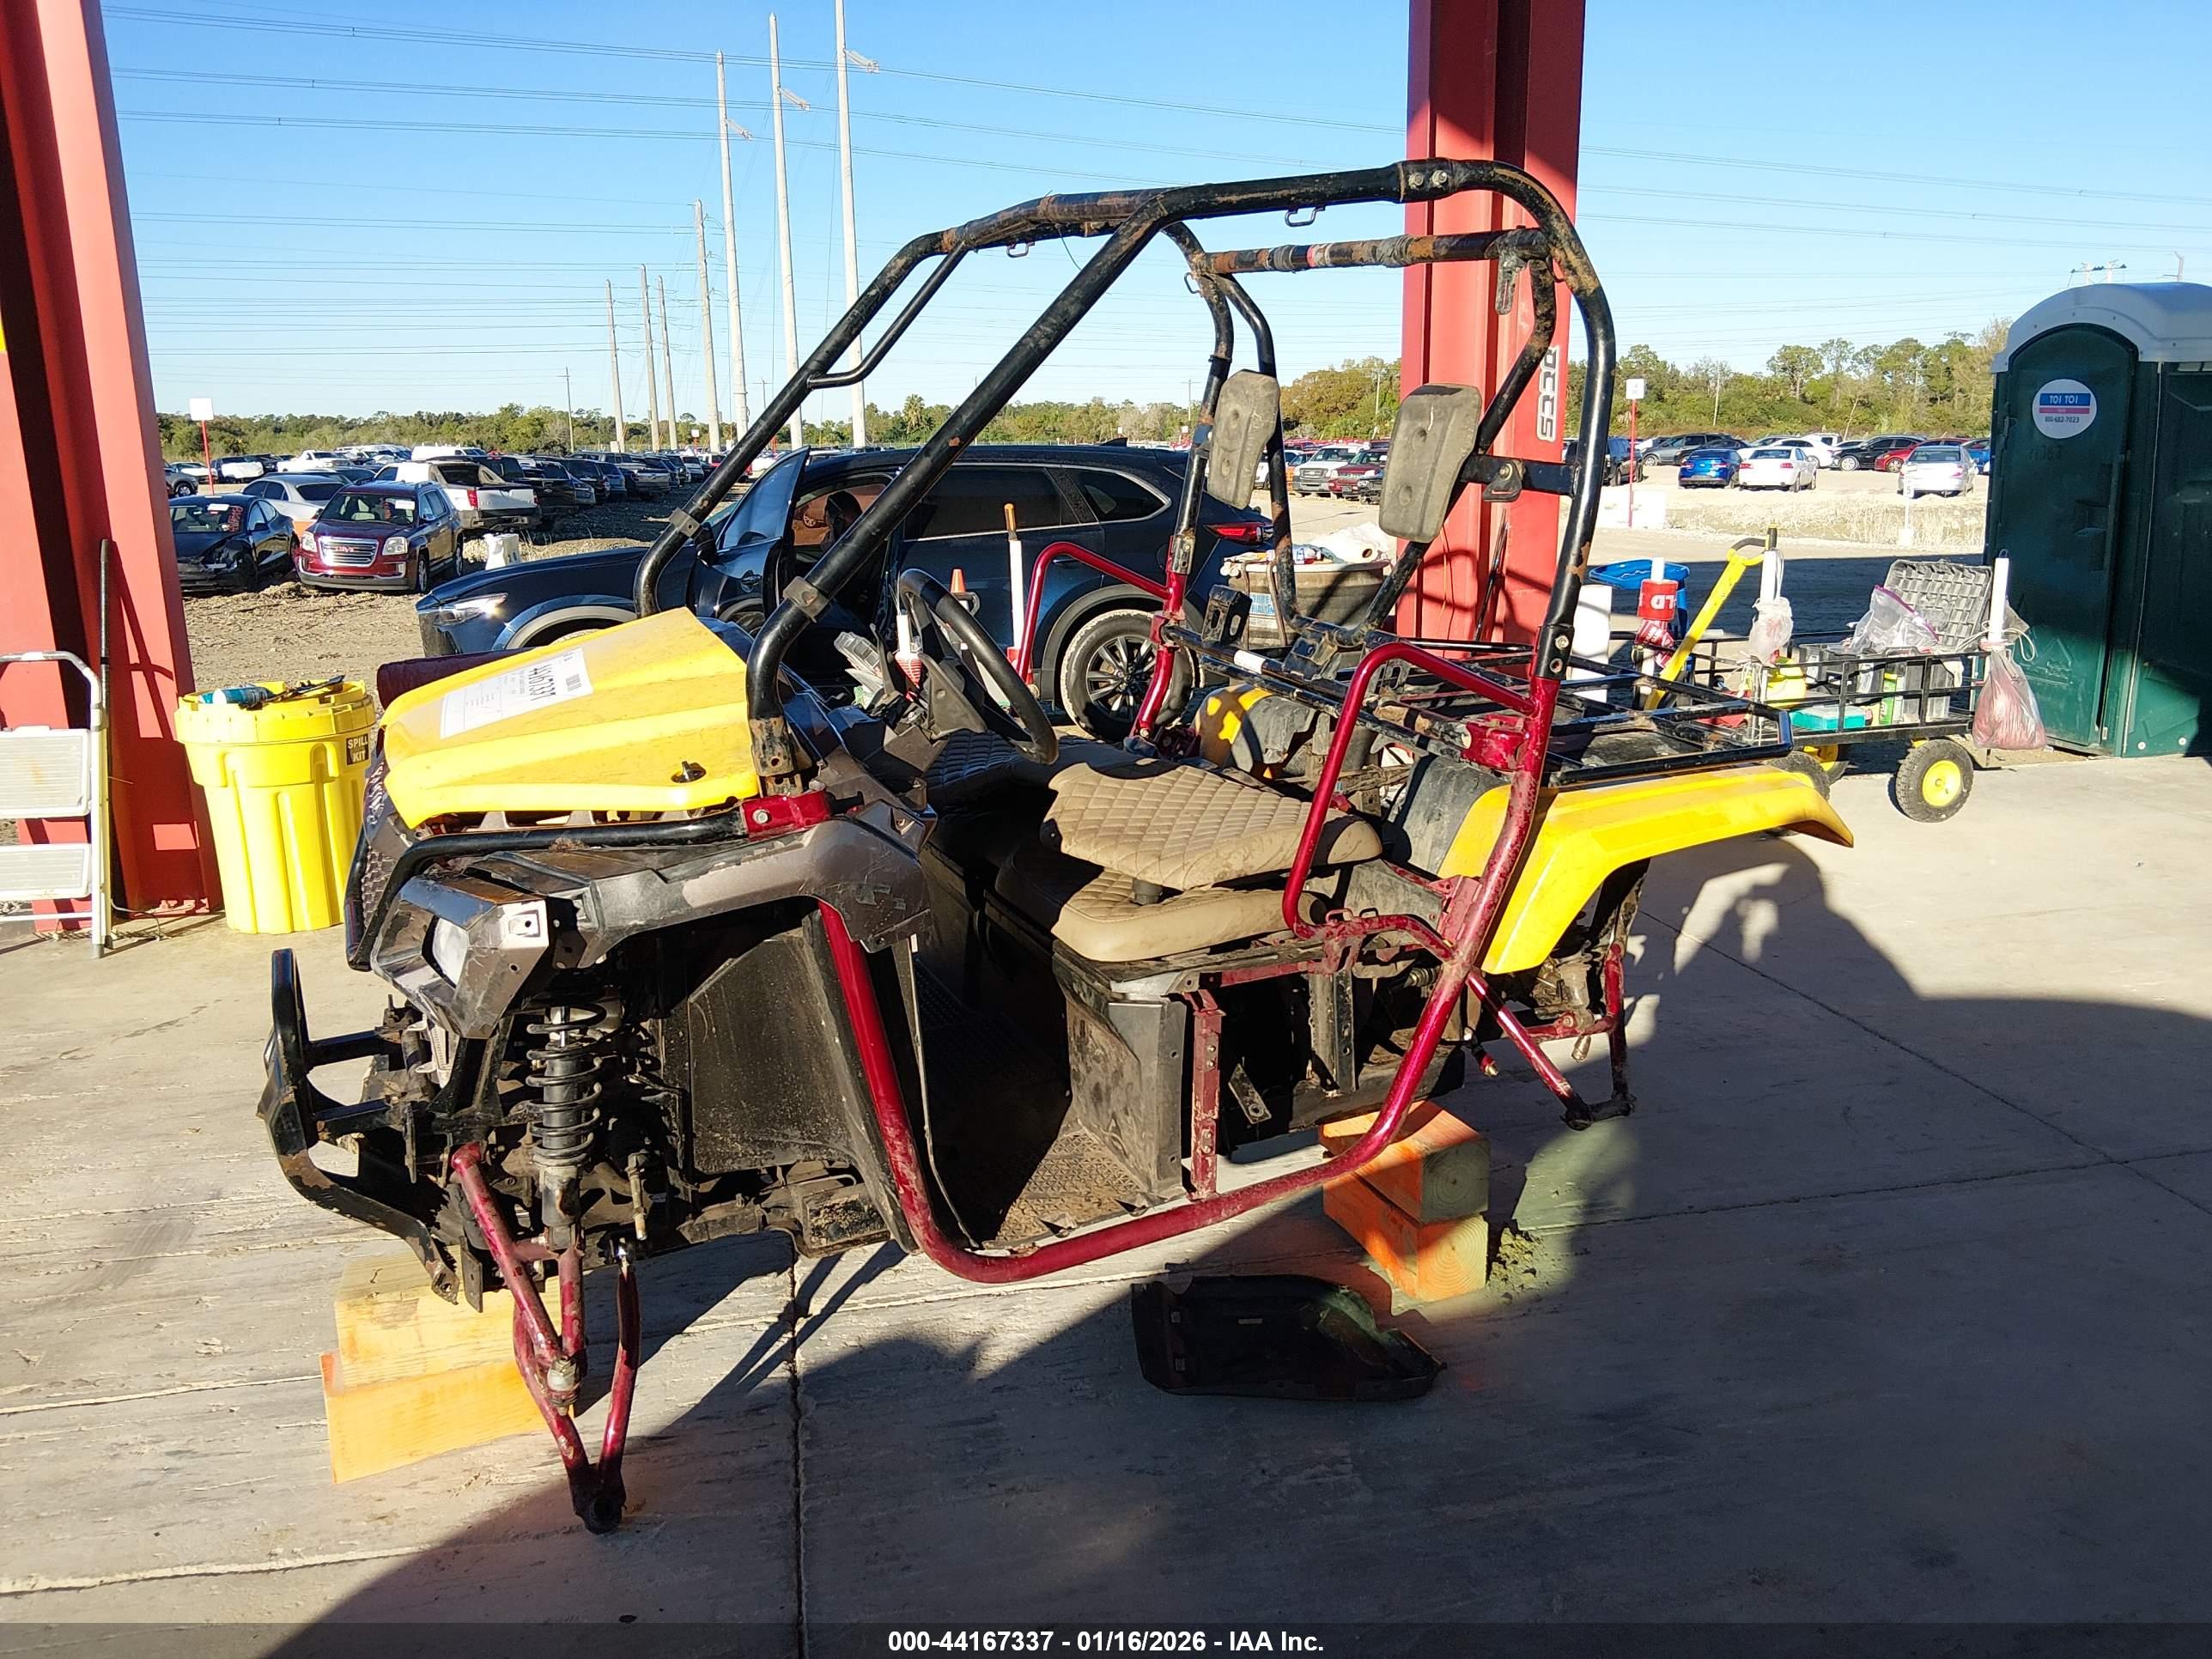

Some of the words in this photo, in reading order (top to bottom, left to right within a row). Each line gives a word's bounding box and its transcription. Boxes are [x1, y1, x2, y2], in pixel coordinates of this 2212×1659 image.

[2050, 395, 2062, 404] TOI
[2065, 395, 2079, 404] TOI
[528, 663, 556, 702] 44167337
[347, 735, 368, 750] SPILL
[352, 750, 366, 763] KIT
